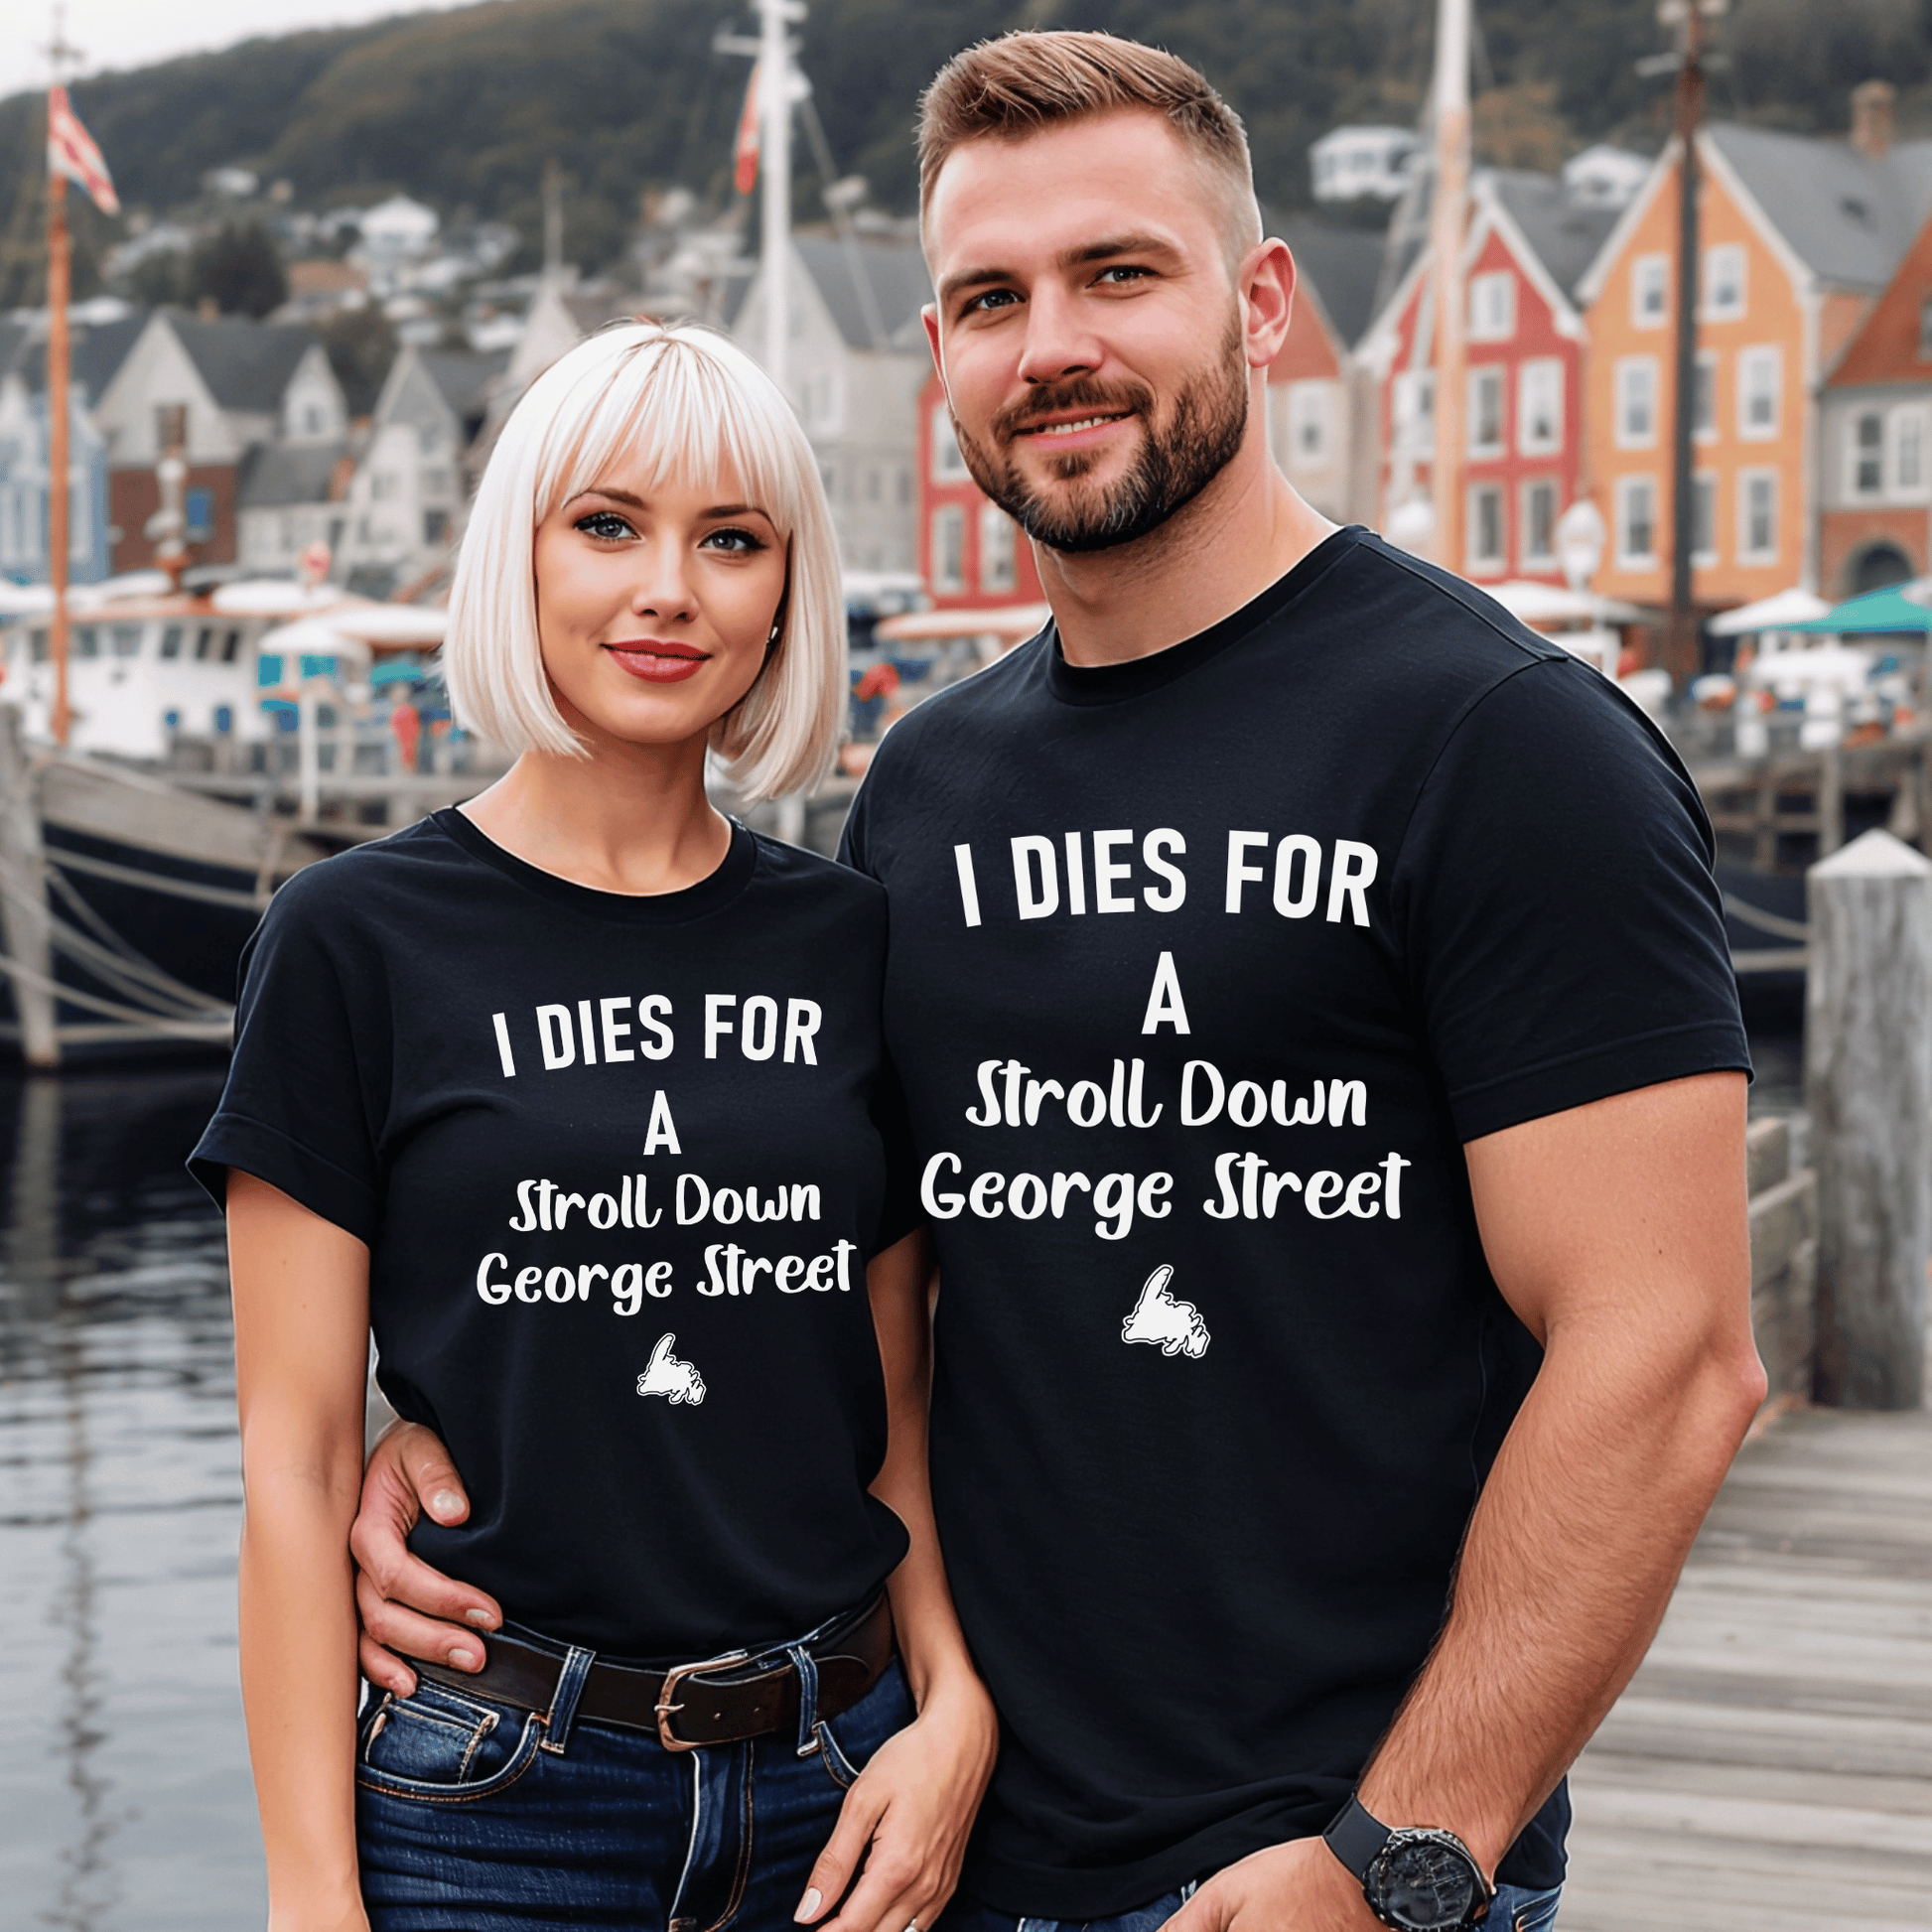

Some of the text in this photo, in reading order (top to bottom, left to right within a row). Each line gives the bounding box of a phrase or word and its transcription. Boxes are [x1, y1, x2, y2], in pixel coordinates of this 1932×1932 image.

[953, 827, 1379, 927] I DIES FOR
[1141, 951, 1191, 1035] A
[491, 994, 822, 1078] I DIES FOR
[642, 1089, 682, 1156] A
[965, 1057, 1367, 1129] Stroll Down
[508, 1173, 821, 1232] Stroll Down
[920, 1152, 1412, 1241] George Street
[477, 1239, 858, 1316] George Street
